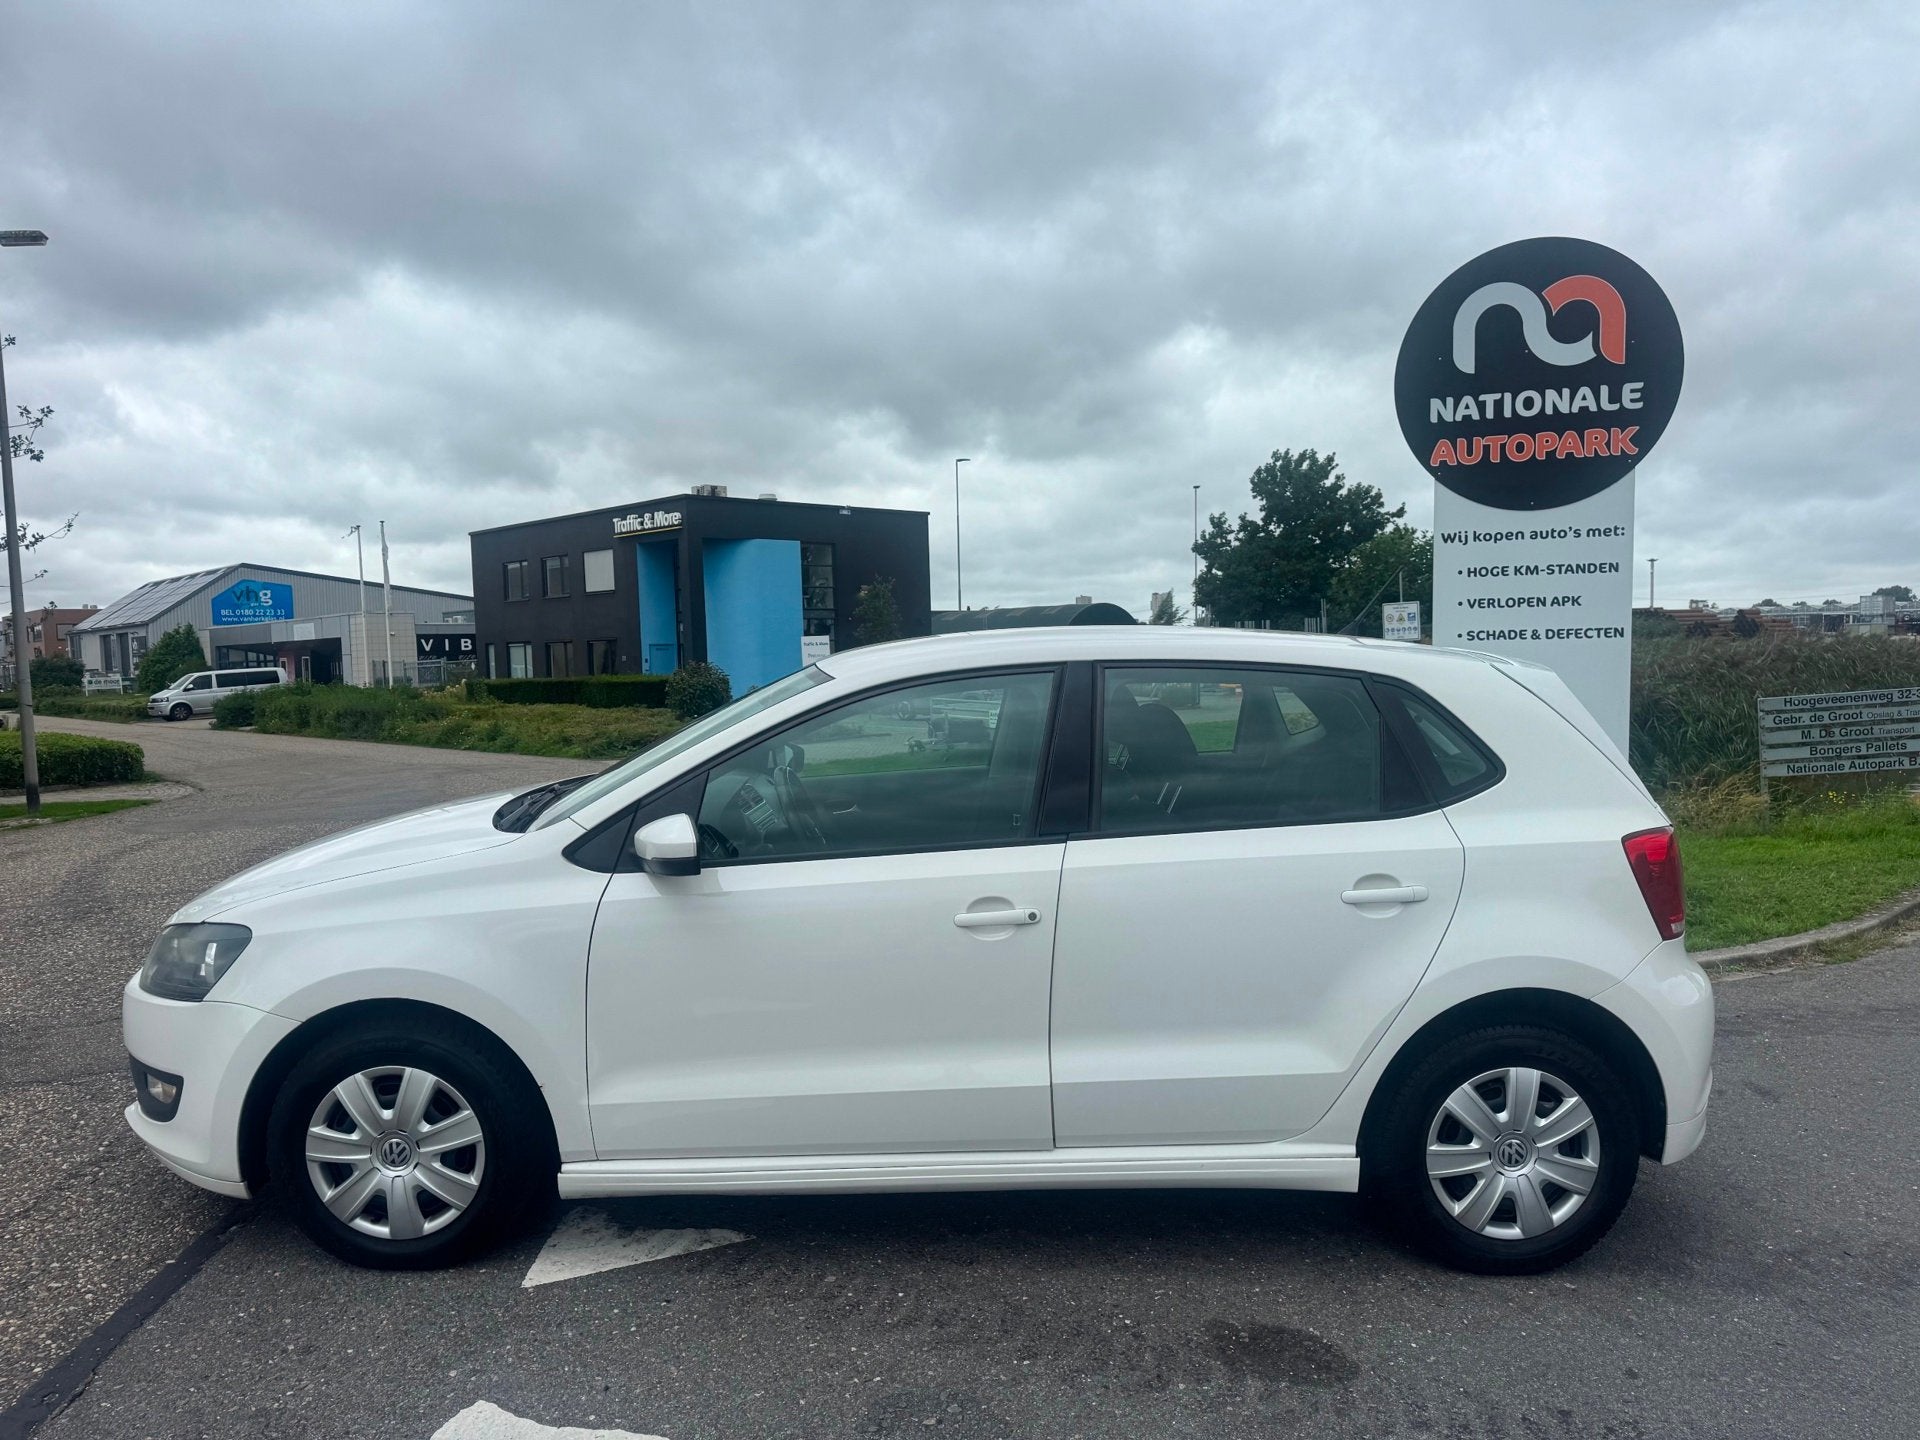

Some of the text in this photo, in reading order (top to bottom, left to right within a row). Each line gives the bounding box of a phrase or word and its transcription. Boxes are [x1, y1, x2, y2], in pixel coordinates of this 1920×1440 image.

[1430, 382, 1644, 423] NATIONALE
[1430, 426, 1640, 467] AUTOPARK
[613, 510, 682, 533] Traffic & More
[1441, 525, 1625, 545] Wij kopen auto's met:
[1467, 562, 1620, 578] HOGE KM-STANDEN
[232, 586, 272, 606] vhg
[1467, 595, 1582, 609] VERLOPEN APK
[1466, 627, 1625, 641] SCHADE & DEFECTEN
[1784, 692, 1893, 708] Hoogeveenenweg
[1773, 714, 1806, 725] Gebr.
[1809, 713, 1824, 722] de
[1828, 710, 1863, 721] Groot
[1867, 710, 1894, 720] Opslag
[1801, 726, 1915, 740] M. De Groot Transport
[1810, 741, 1907, 756] Bongers Pallets
[1787, 762, 1845, 774] Nationale
[1849, 758, 1905, 770] Autopark
